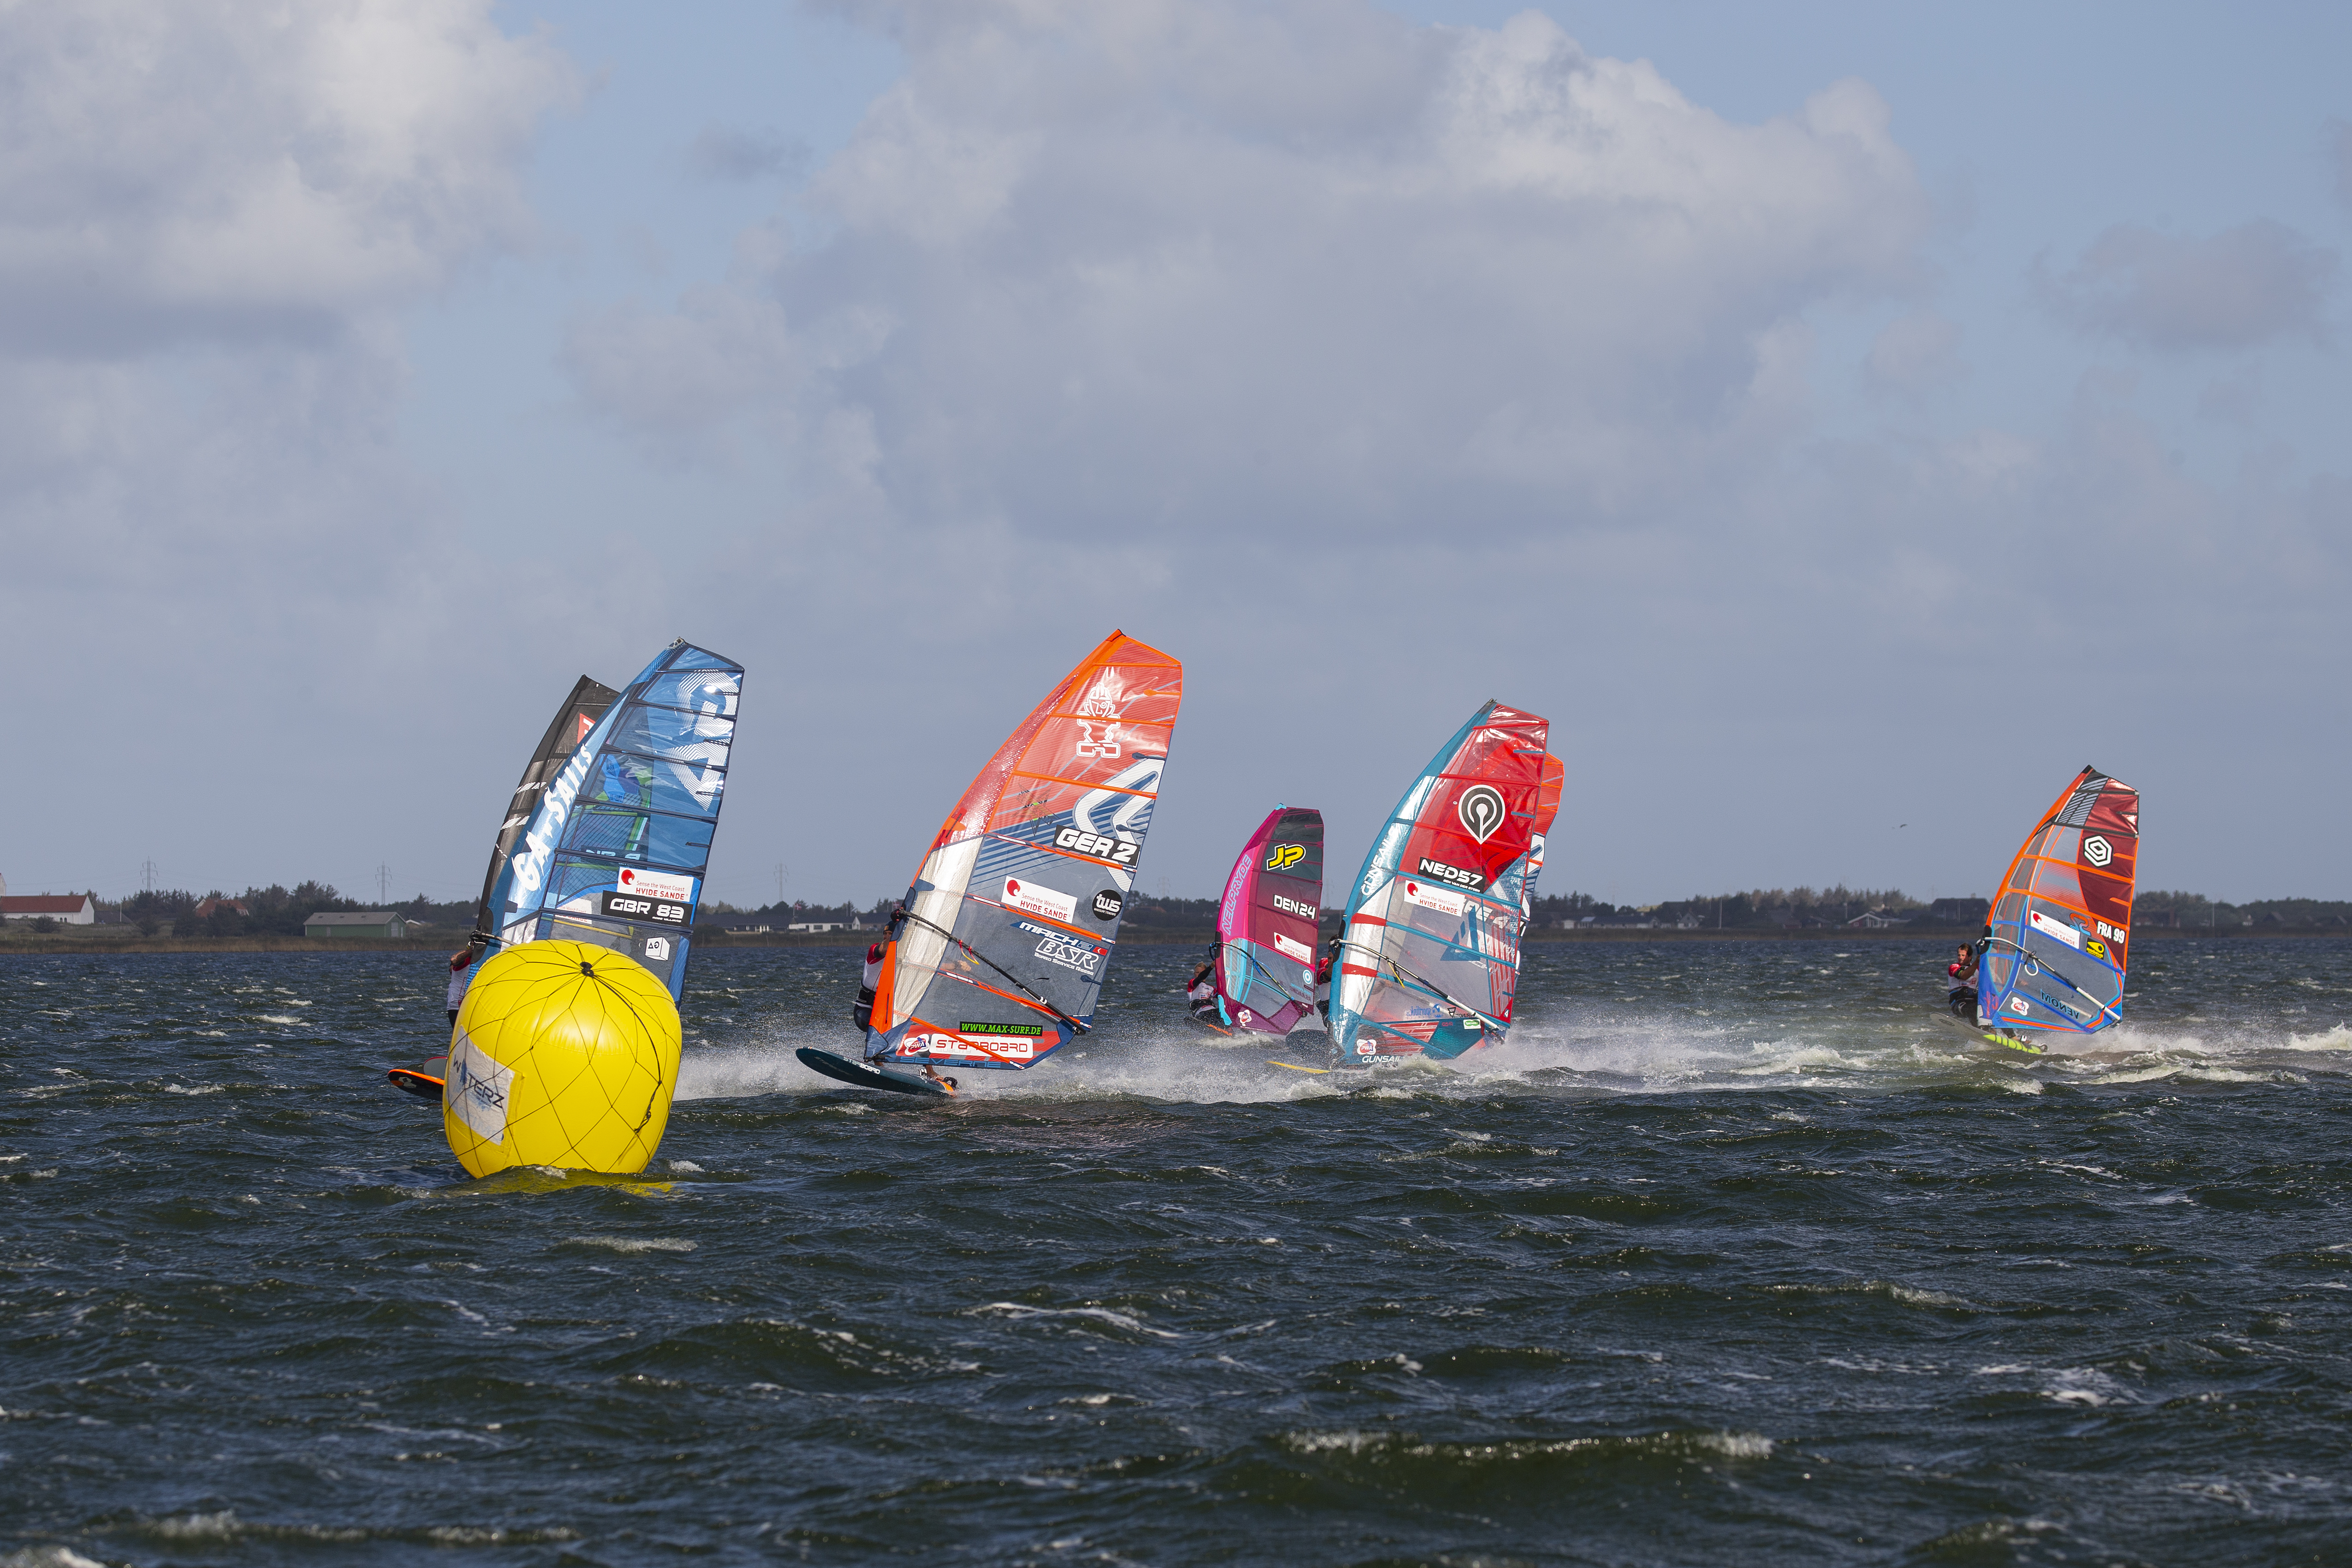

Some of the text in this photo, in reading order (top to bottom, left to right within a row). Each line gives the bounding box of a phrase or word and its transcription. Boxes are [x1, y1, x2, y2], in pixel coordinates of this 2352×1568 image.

[1056, 828, 1137, 863] GER 2
[1268, 845, 1305, 869] JP
[1419, 859, 1483, 886] NED57
[635, 887, 684, 900] HVIDE SANDE
[1222, 854, 1252, 936] NEILPRYDE
[610, 898, 684, 919] GBR 83
[1020, 900, 1042, 912] HVIDE
[1044, 907, 1067, 920] SANDE
[1056, 903, 1068, 912] Coast
[1419, 899, 1458, 915] HVIDE SANDE
[2043, 927, 2076, 946] HVIDE SANDE
[2097, 921, 2125, 944] FRA 99
[1035, 937, 1099, 970] BSR
[1284, 947, 1308, 962] HVIDE SANDE
[961, 1023, 1041, 1035] WWW.MAX-SURF.DE
